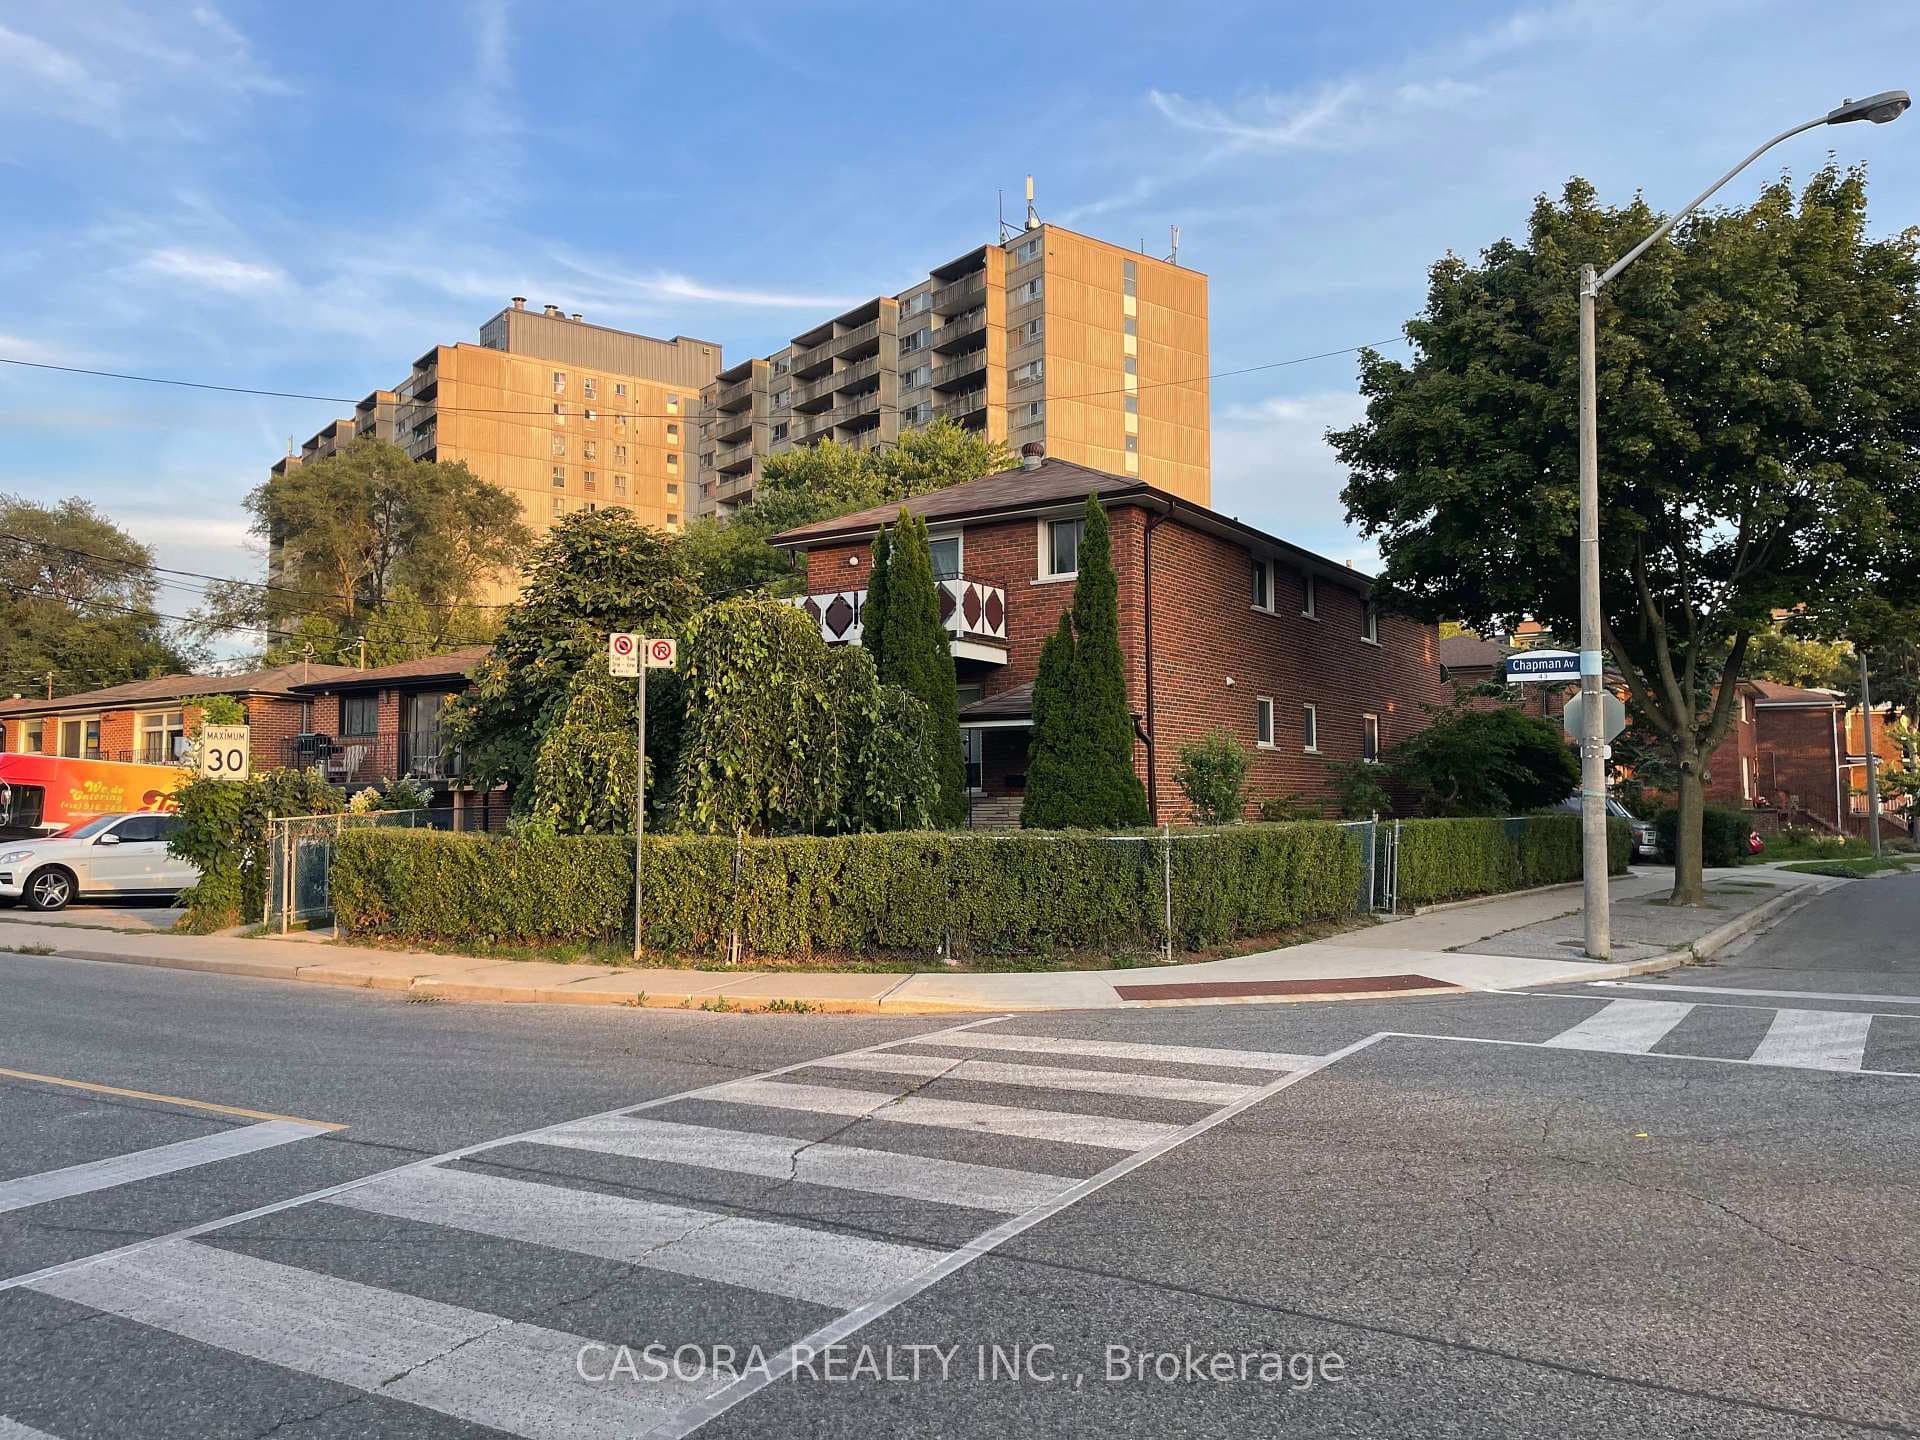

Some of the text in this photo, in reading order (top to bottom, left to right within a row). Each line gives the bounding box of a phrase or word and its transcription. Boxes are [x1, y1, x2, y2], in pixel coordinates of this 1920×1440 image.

[1513, 659, 1574, 671] Chapman Av
[207, 732, 245, 740] MAXIMUM
[208, 748, 243, 771] 30
[84, 780, 108, 794] We
[69, 788, 123, 802] Catering
